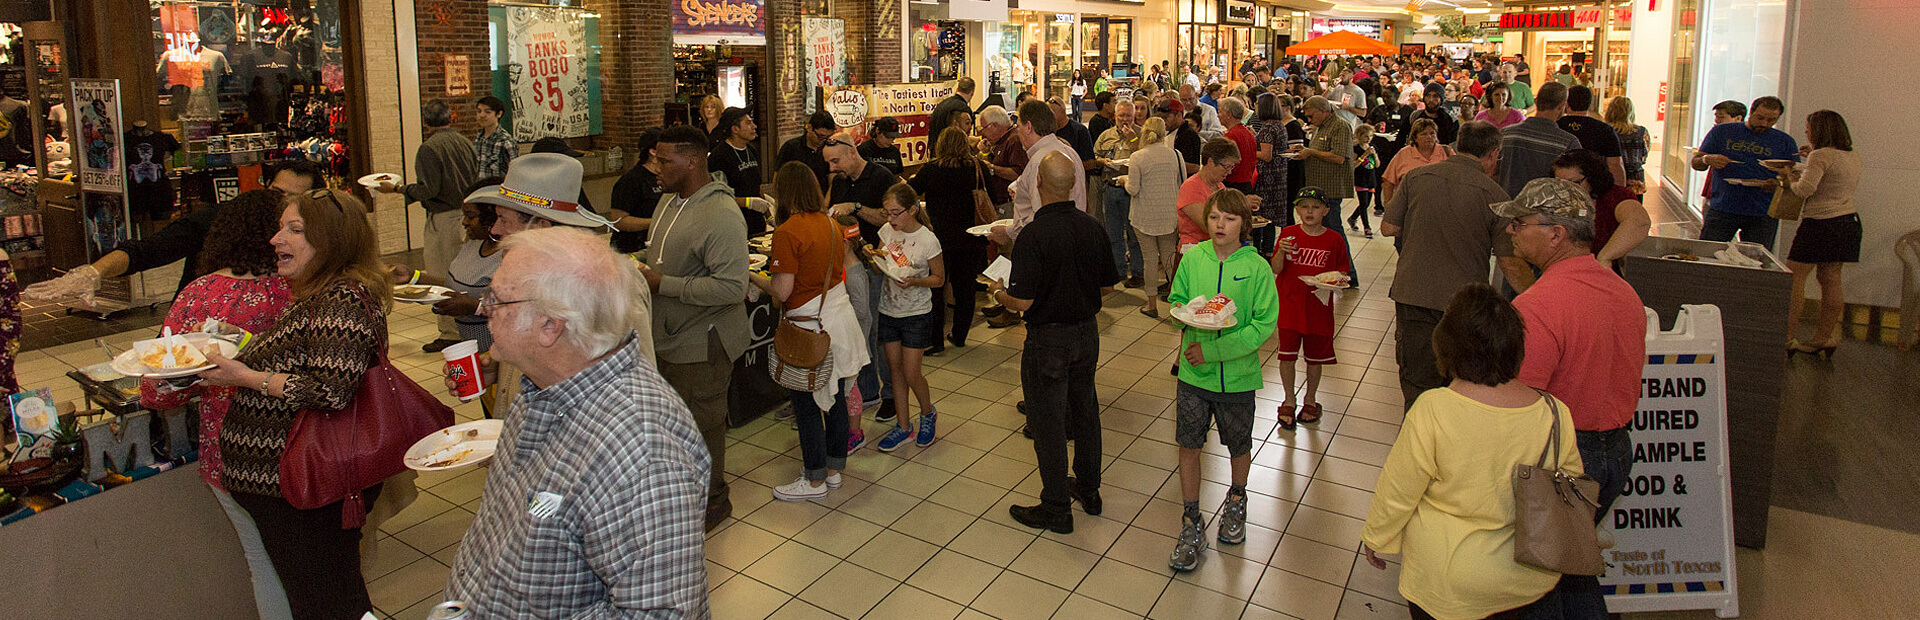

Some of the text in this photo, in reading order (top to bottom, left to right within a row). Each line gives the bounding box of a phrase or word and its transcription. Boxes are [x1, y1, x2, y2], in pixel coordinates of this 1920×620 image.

[681, 0, 758, 28] SPENCER'S
[525, 40, 567, 58] TANKS
[813, 41, 835, 55] TANKS
[528, 56, 569, 78] BOGO
[815, 53, 835, 69] BOGO
[74, 88, 114, 102] PACK IT UP
[532, 76, 564, 112] $5
[892, 89, 928, 99] Tastiest
[890, 101, 916, 113] North
[920, 101, 938, 112] Tex
[569, 113, 589, 124] USA
[1725, 138, 1773, 156] texas
[84, 172, 95, 184] GET
[1294, 248, 1331, 267] NIKE
[1633, 442, 1707, 463] AMPLE
[1621, 474, 1687, 496] OOD &
[1614, 507, 1683, 530] DRINK
[1610, 549, 1666, 561] Taste of
[1622, 560, 1722, 576] North Texas
